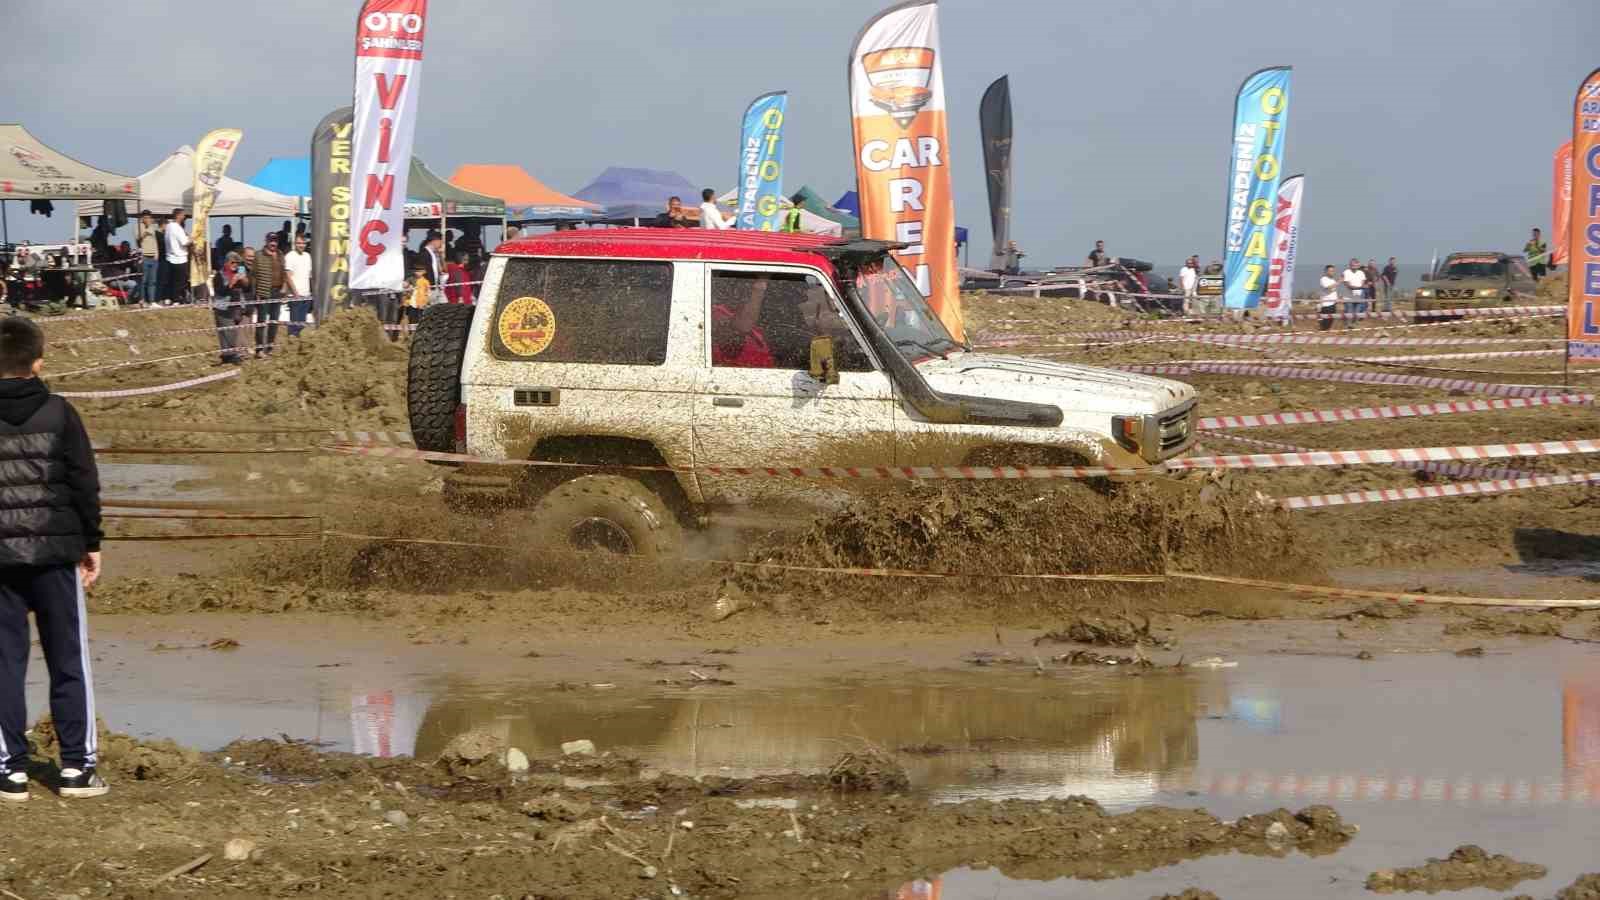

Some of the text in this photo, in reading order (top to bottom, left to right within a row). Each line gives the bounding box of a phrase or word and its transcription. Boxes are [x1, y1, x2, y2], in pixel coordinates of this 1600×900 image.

[365, 12, 422, 33] OTO
[743, 136, 761, 231] ARADENİZ
[760, 107, 784, 182] OTO
[861, 136, 942, 171] CAR
[1229, 123, 1256, 252] KARADENİZ
[1245, 87, 1285, 291] OTO GAZ
